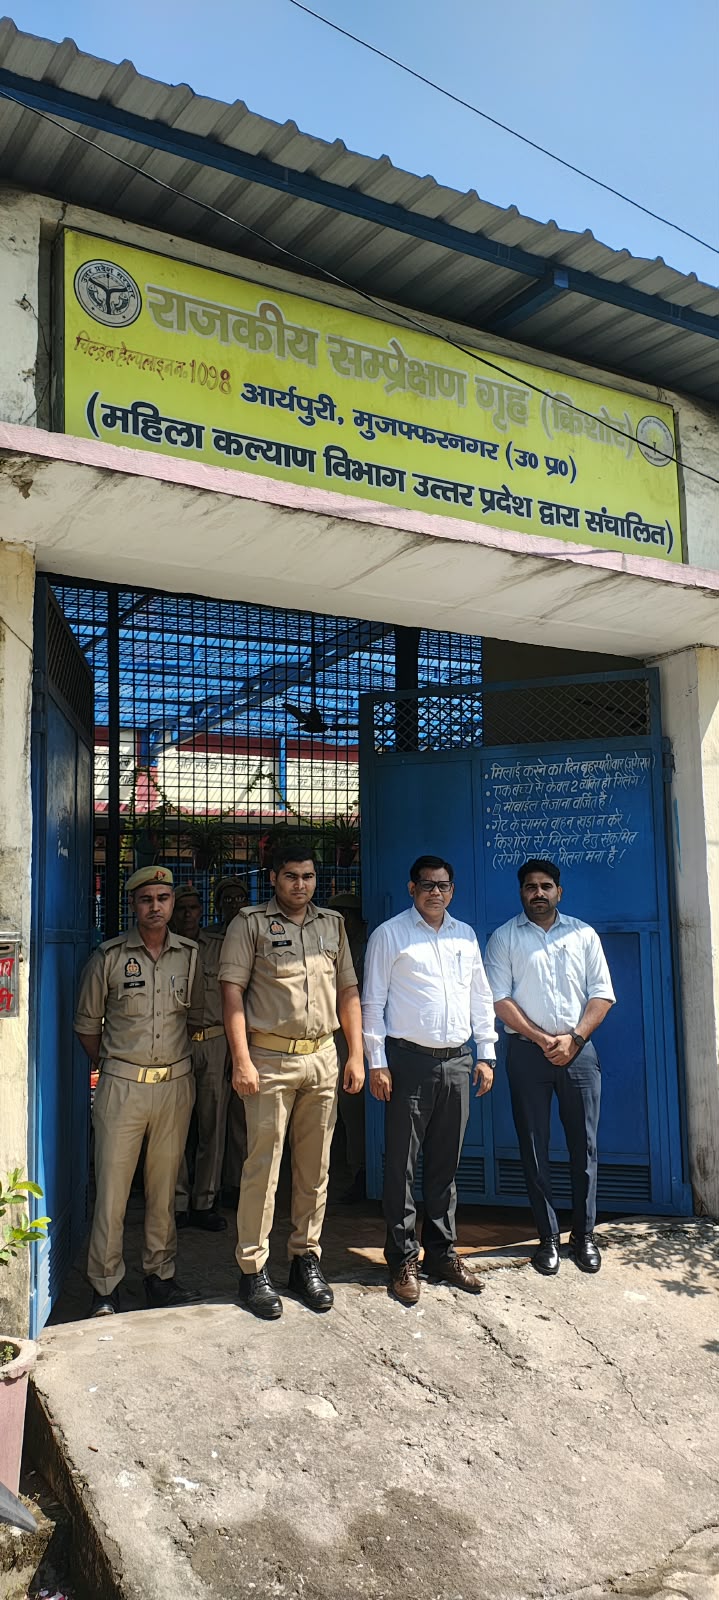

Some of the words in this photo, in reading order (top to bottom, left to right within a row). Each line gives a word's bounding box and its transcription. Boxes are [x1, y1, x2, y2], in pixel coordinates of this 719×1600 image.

[146, 285, 321, 368] राजकीय
[327, 337, 468, 408] सम्प्रेक्षण
[474, 376, 531, 432] गृह
[190, 359, 232, 394] 1098
[241, 383, 344, 426] आर्यपुरी,
[353, 409, 499, 460] मुजफ्फरनगर
[87, 391, 205, 449] (महिला
[212, 428, 316, 472] कल्याण
[323, 445, 406, 492] विभाग
[412, 473, 475, 507] उत्तर
[479, 484, 533, 518] प्रदेश
[538, 500, 580, 528] द्वारा
[585, 506, 674, 554] संचालित)
[548, 763, 564, 776] का
[565, 757, 581, 778] दिन
[493, 785, 511, 801] एक
[535, 778, 546, 798] से
[546, 777, 571, 795] केवल
[571, 780, 578, 793] 2
[492, 814, 509, 832] गेट
[551, 816, 576, 835] वाहन
[597, 815, 608, 828] न
[534, 830, 547, 851] से
[586, 850, 607, 863] मना
